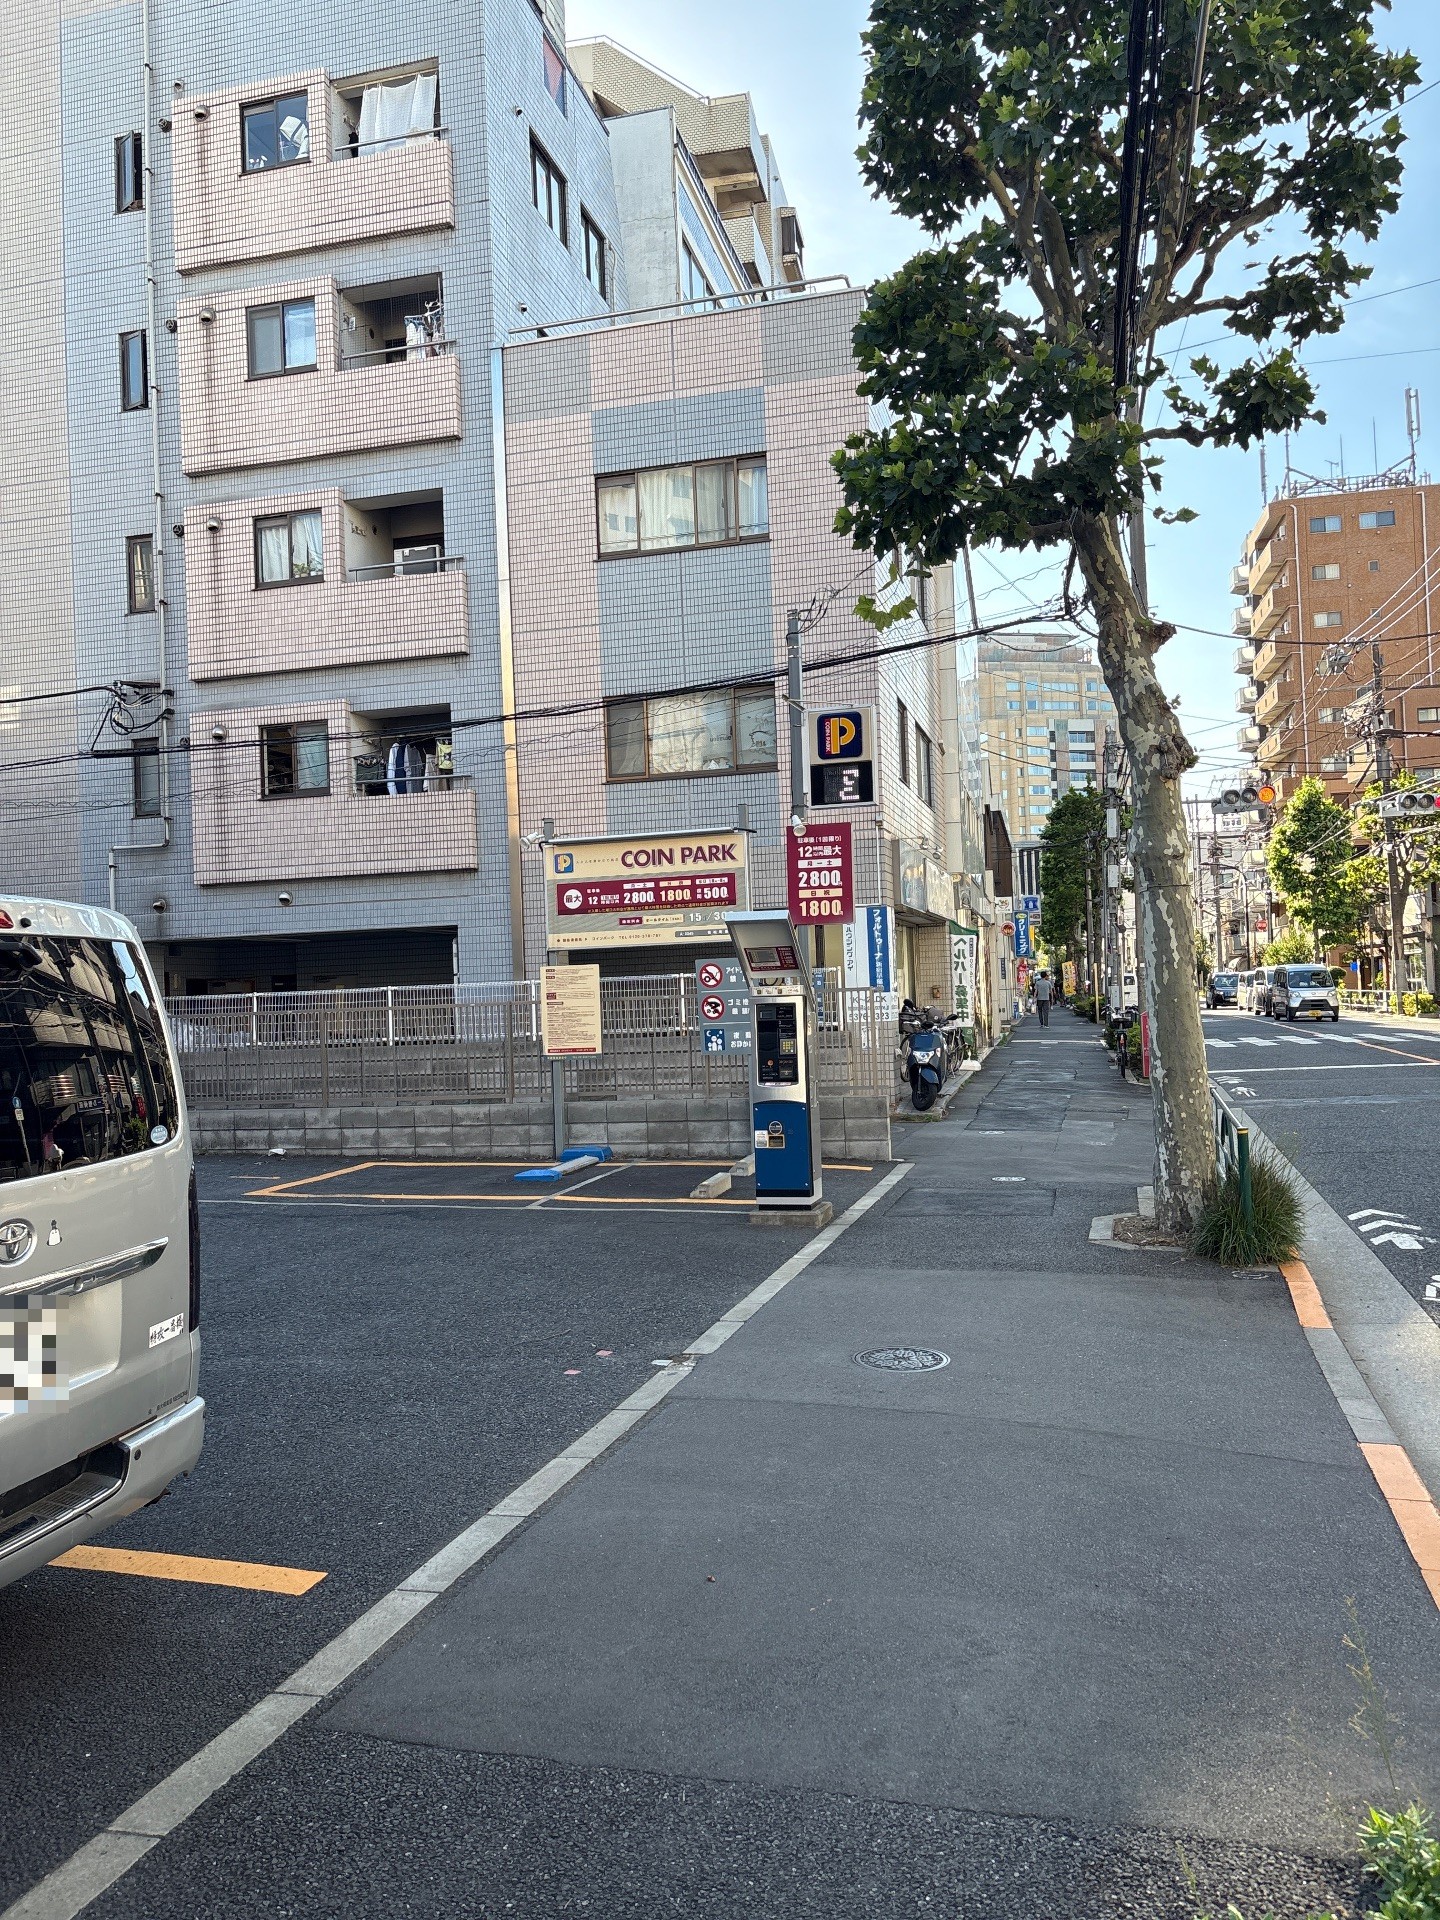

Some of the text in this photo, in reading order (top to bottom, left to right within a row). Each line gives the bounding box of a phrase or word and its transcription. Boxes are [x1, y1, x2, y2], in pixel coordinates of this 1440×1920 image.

[621, 843, 737, 870] COIN PARK
[565, 894, 582, 903] 最大
[1017, 918, 1029, 954] クリーニング
